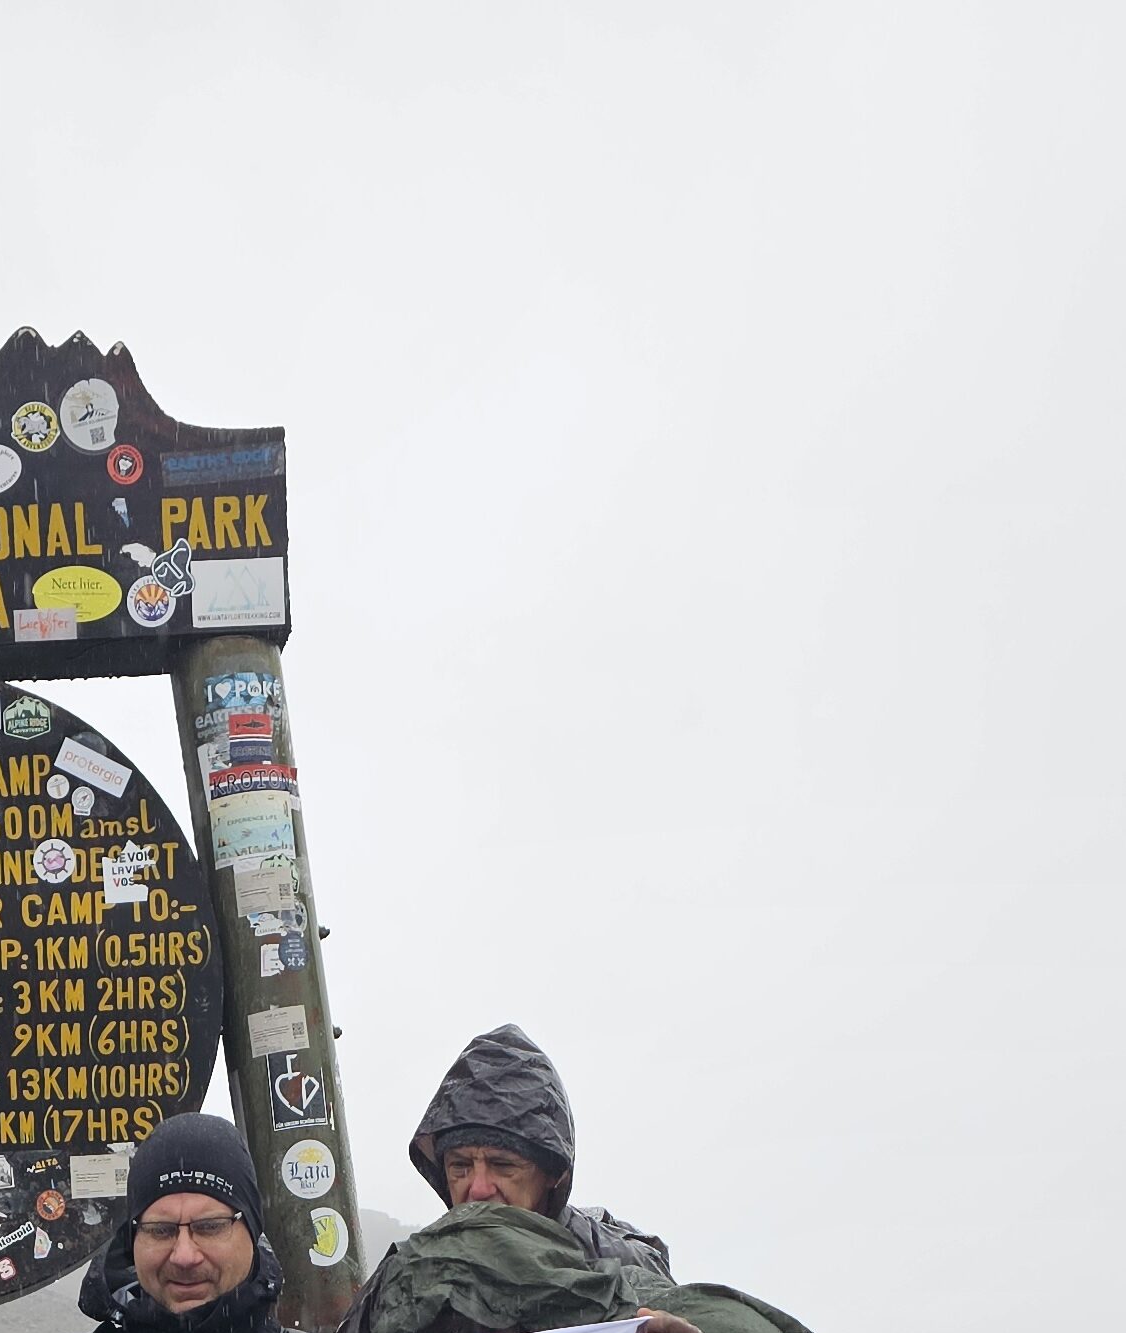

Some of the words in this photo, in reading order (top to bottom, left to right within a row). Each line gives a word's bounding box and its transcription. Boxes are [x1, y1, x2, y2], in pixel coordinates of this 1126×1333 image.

[161, 494, 272, 551] PARK
[63, 749, 124, 787] protergia
[79, 798, 156, 839] amsl
[21, 891, 116, 928] CAMP
